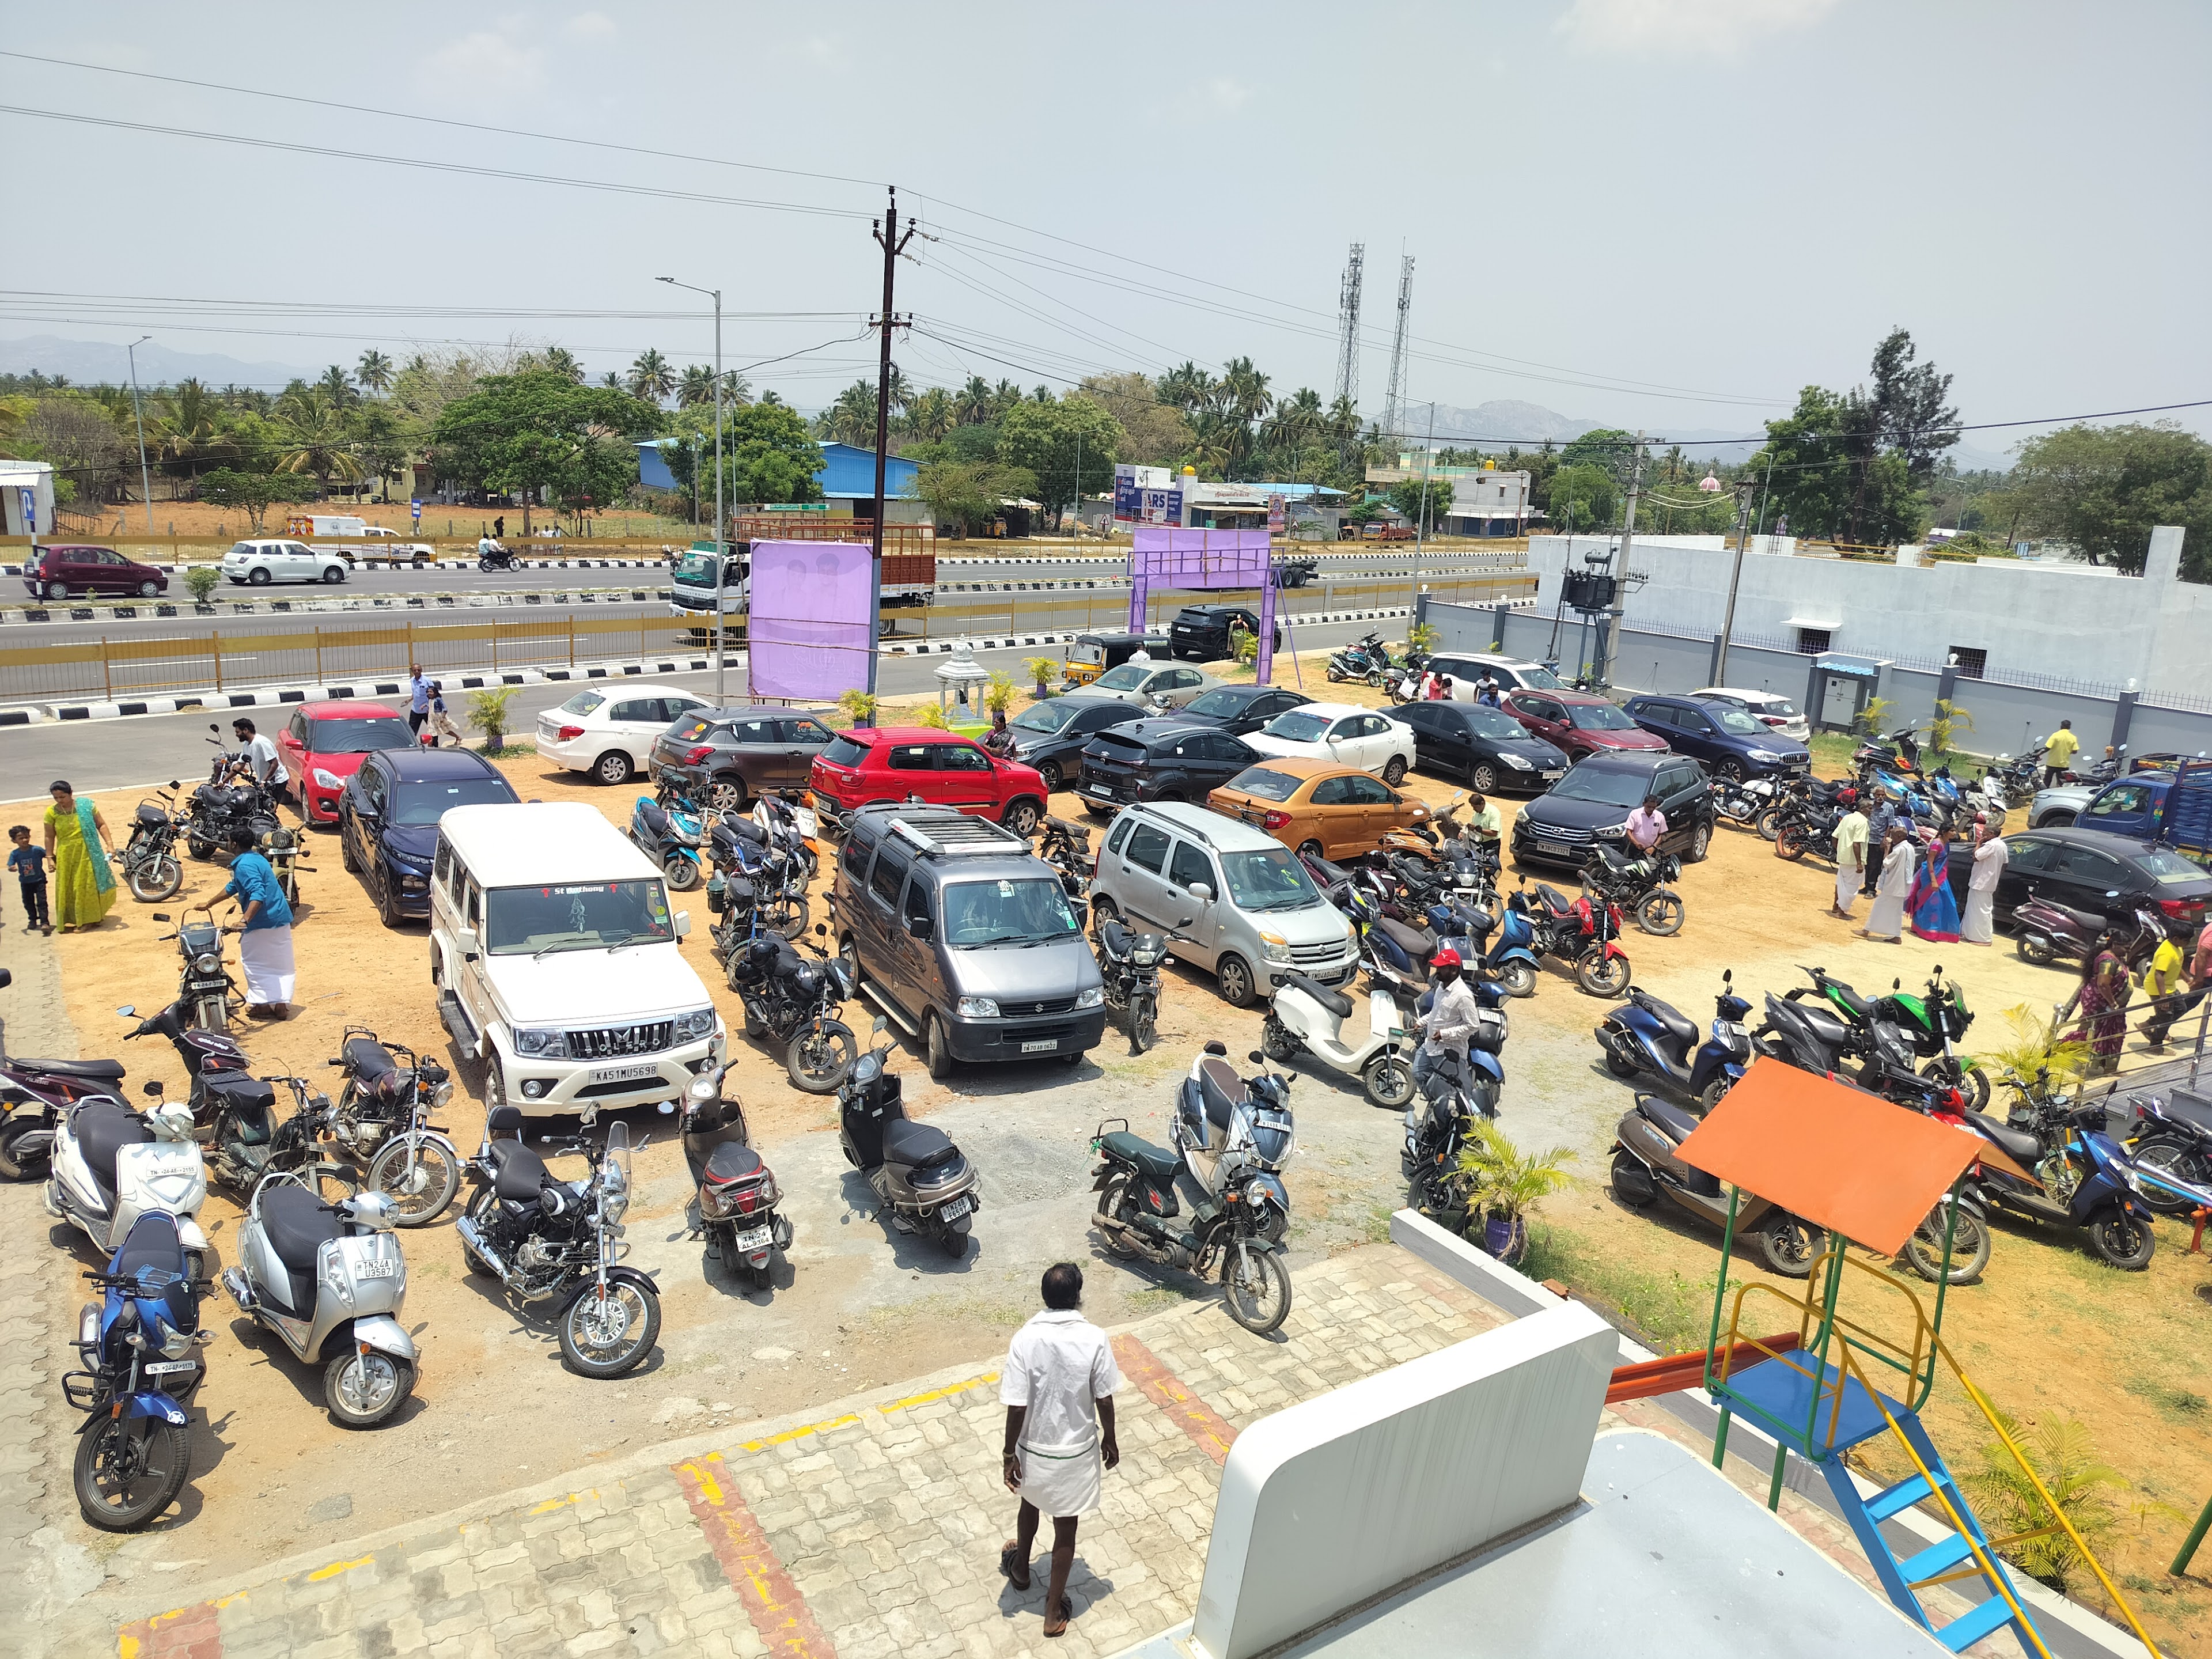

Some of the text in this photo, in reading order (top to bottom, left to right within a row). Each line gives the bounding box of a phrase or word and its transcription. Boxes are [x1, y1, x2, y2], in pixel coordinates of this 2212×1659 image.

[1144, 493, 1165, 508] ARS
[596, 1066, 657, 1081] KA51MU5698
[363, 1260, 389, 1270] TN24A
[365, 1268, 391, 1277] U3587
